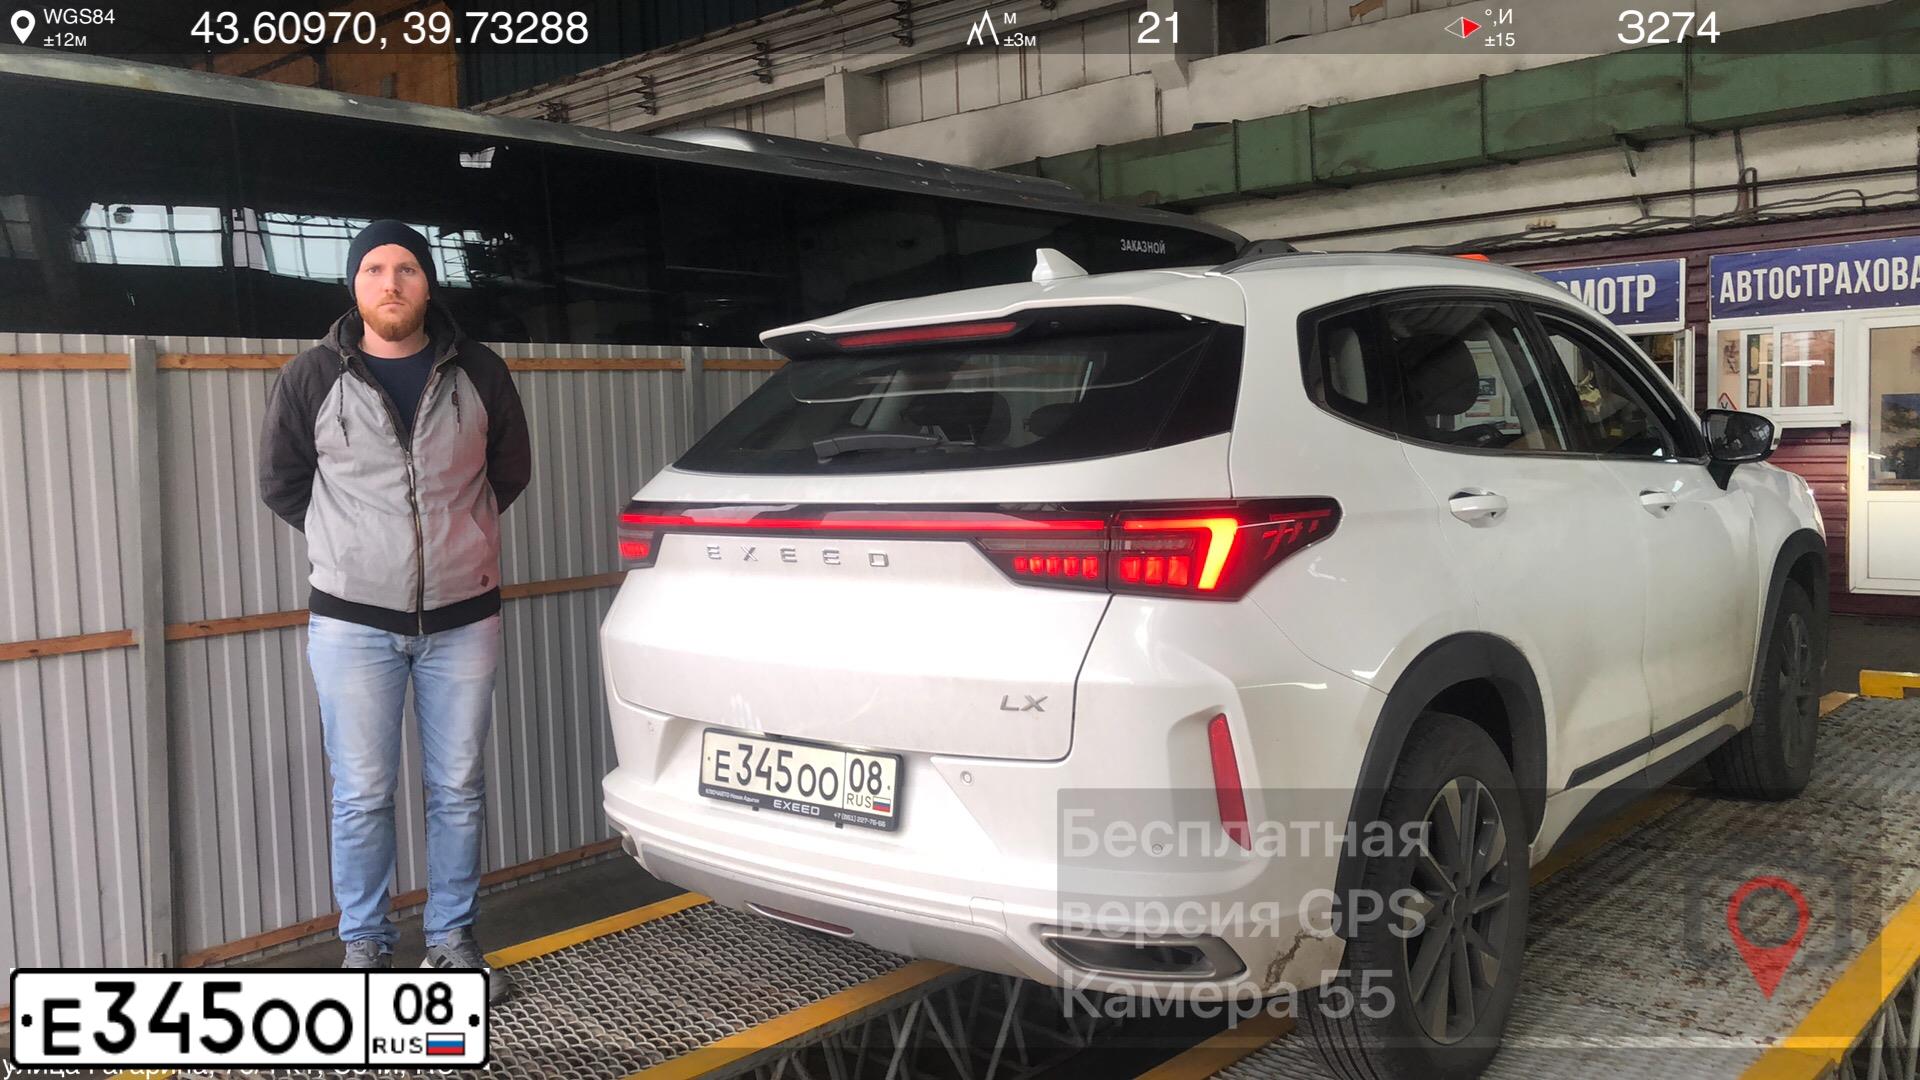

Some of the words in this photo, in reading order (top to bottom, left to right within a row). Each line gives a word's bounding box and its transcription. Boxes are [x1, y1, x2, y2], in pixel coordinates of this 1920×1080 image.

[1120, 238, 1166, 254] ЗАКАЗНОЙ
[1556, 274, 1657, 315] МОТР
[706, 545, 890, 568] EXEED
[1000, 694, 1048, 712] LX
[849, 758, 882, 795] 08
[773, 800, 820, 816] EXEED
[846, 793, 872, 809] RUS
